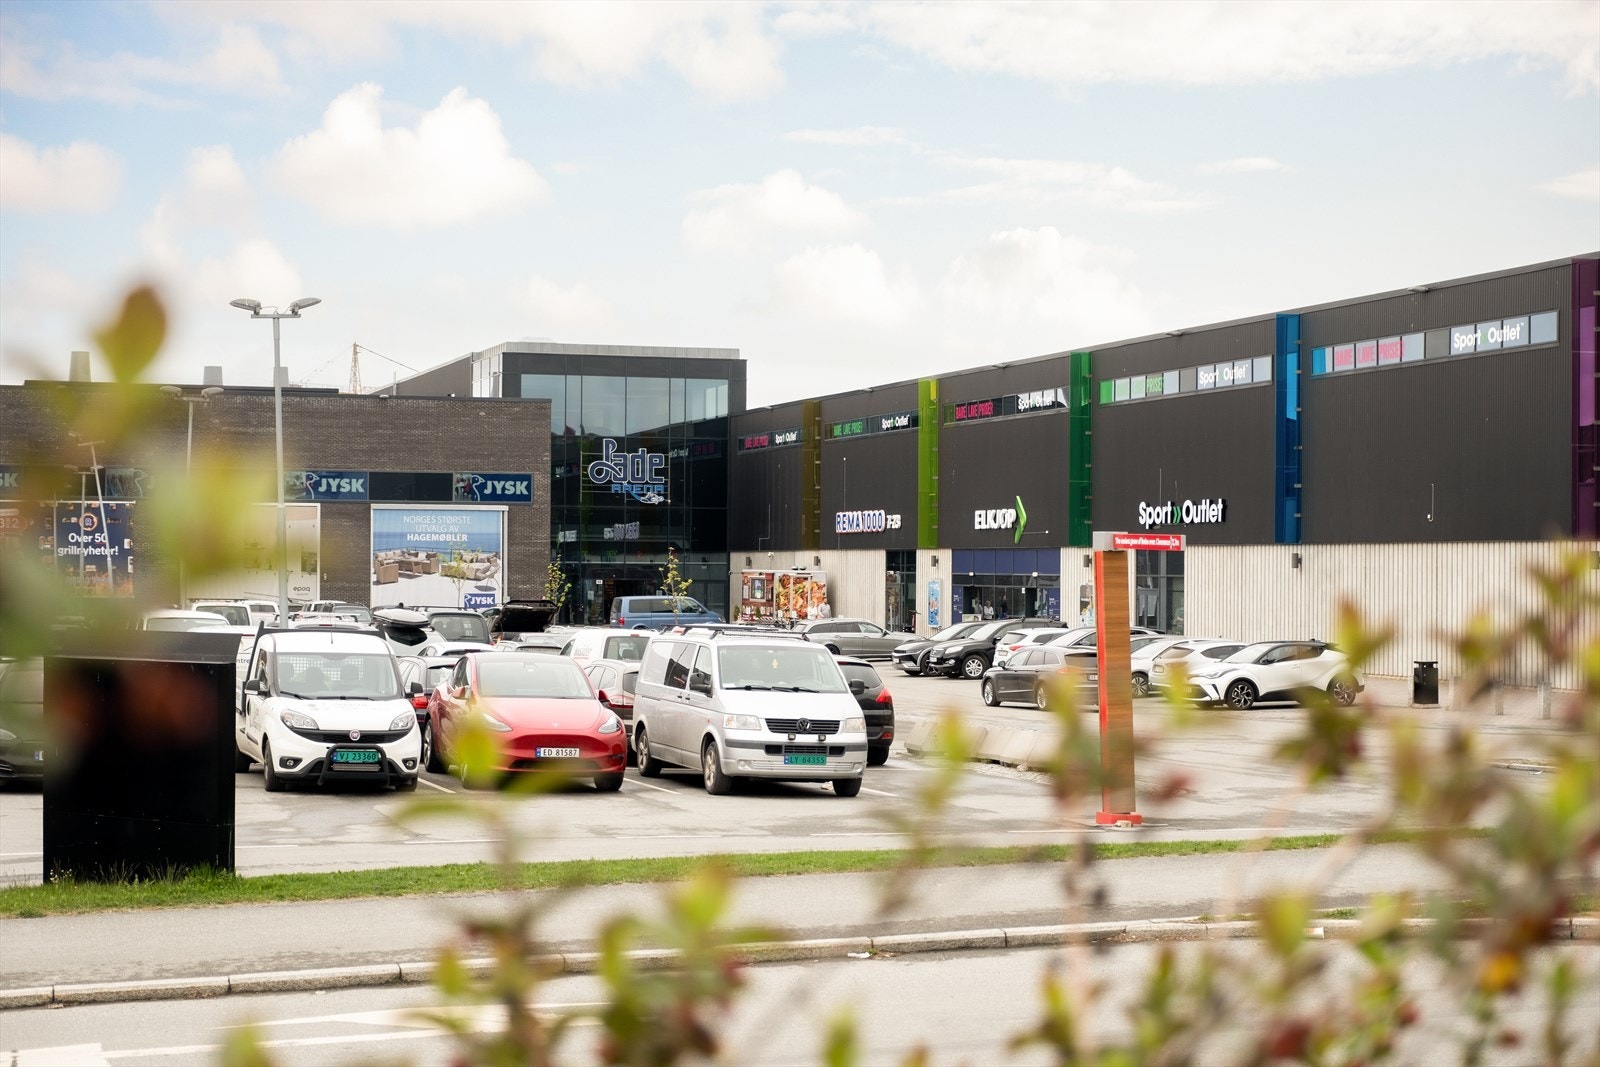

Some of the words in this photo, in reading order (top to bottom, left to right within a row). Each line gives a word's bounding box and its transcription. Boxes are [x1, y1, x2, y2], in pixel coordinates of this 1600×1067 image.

[1454, 329, 1481, 351] Sport
[1487, 326, 1520, 343] Outlet
[1199, 368, 1218, 387] Sport
[1223, 365, 1246, 381] Outlet
[1018, 398, 1033, 412] Sport
[881, 419, 893, 430] Sport
[318, 478, 365, 493] JYSK
[483, 480, 529, 495] JYSK
[1138, 501, 1172, 529] Sport
[1182, 498, 1223, 524] Outlet
[403, 515, 435, 524] NORGES
[437, 515, 472, 524] STØRSTE
[836, 511, 862, 533] REMA
[862, 509, 886, 532] 1000
[415, 524, 447, 533] UTVALG
[448, 525, 460, 533] AV
[68, 533, 93, 543] Over
[94, 533, 108, 543] 50
[407, 533, 468, 542] HAGEMØBLER
[470, 596, 494, 605] JYSK
[339, 752, 349, 760] VJ
[352, 752, 377, 761] 23360
[543, 748, 553, 756] ED
[555, 748, 578, 756] 81587
[789, 756, 799, 764] LY
[802, 756, 825, 764] 64355
